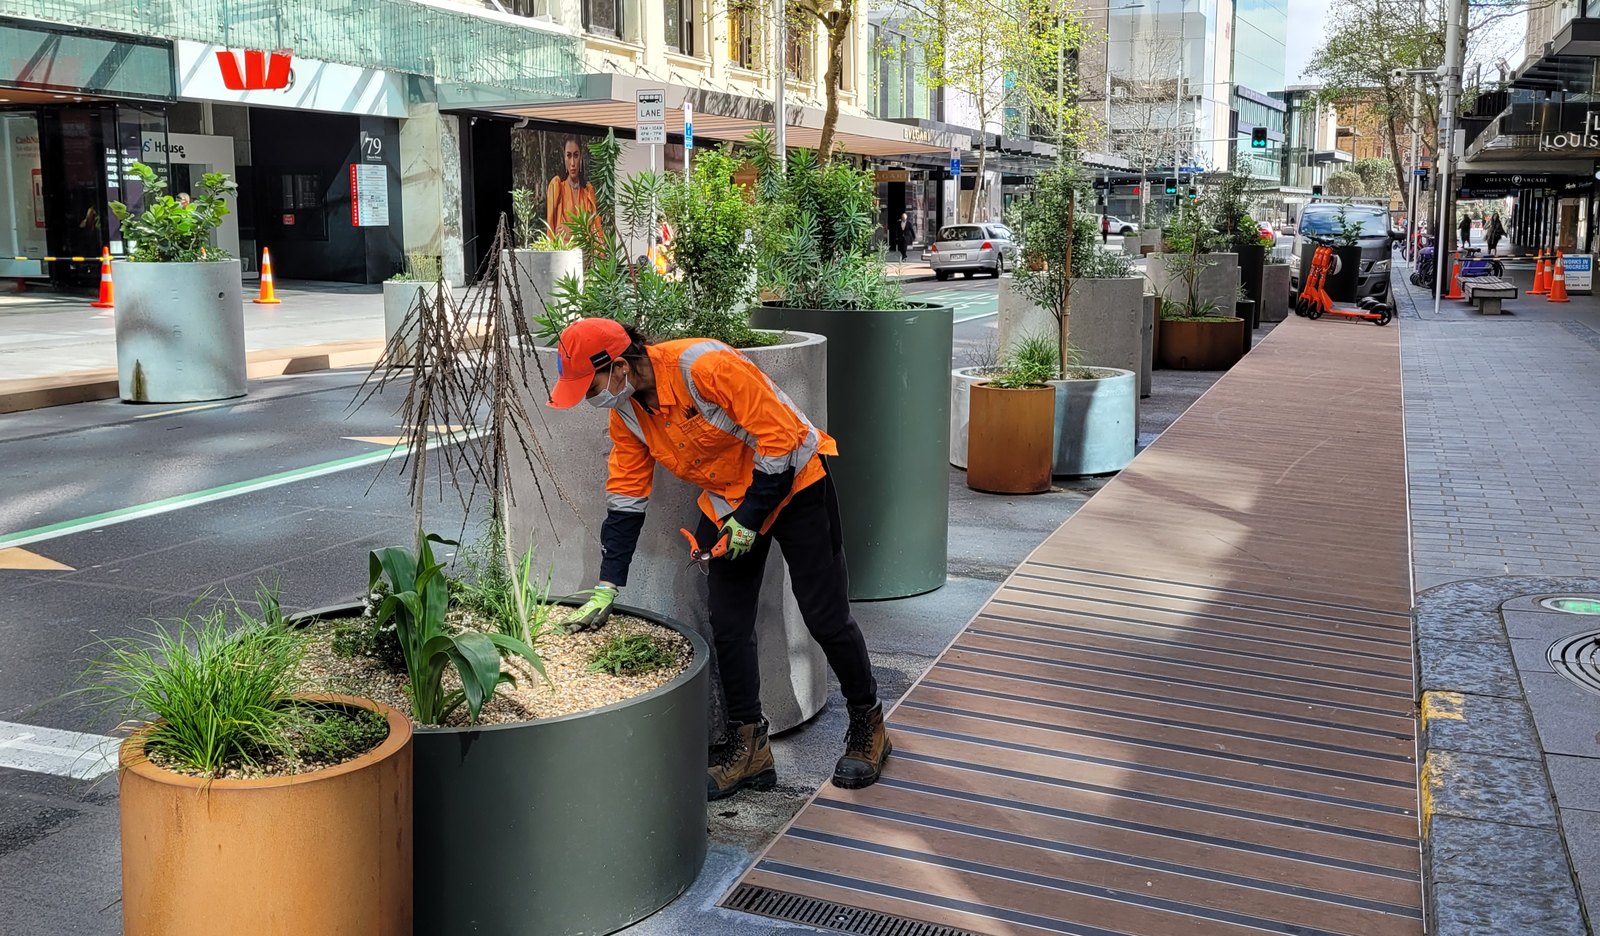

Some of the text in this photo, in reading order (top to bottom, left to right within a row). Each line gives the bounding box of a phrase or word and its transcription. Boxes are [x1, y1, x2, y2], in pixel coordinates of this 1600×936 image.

[904, 128, 930, 142] BVLGARI
[1546, 135, 1599, 148] LOUIS
[365, 138, 382, 155] 79
